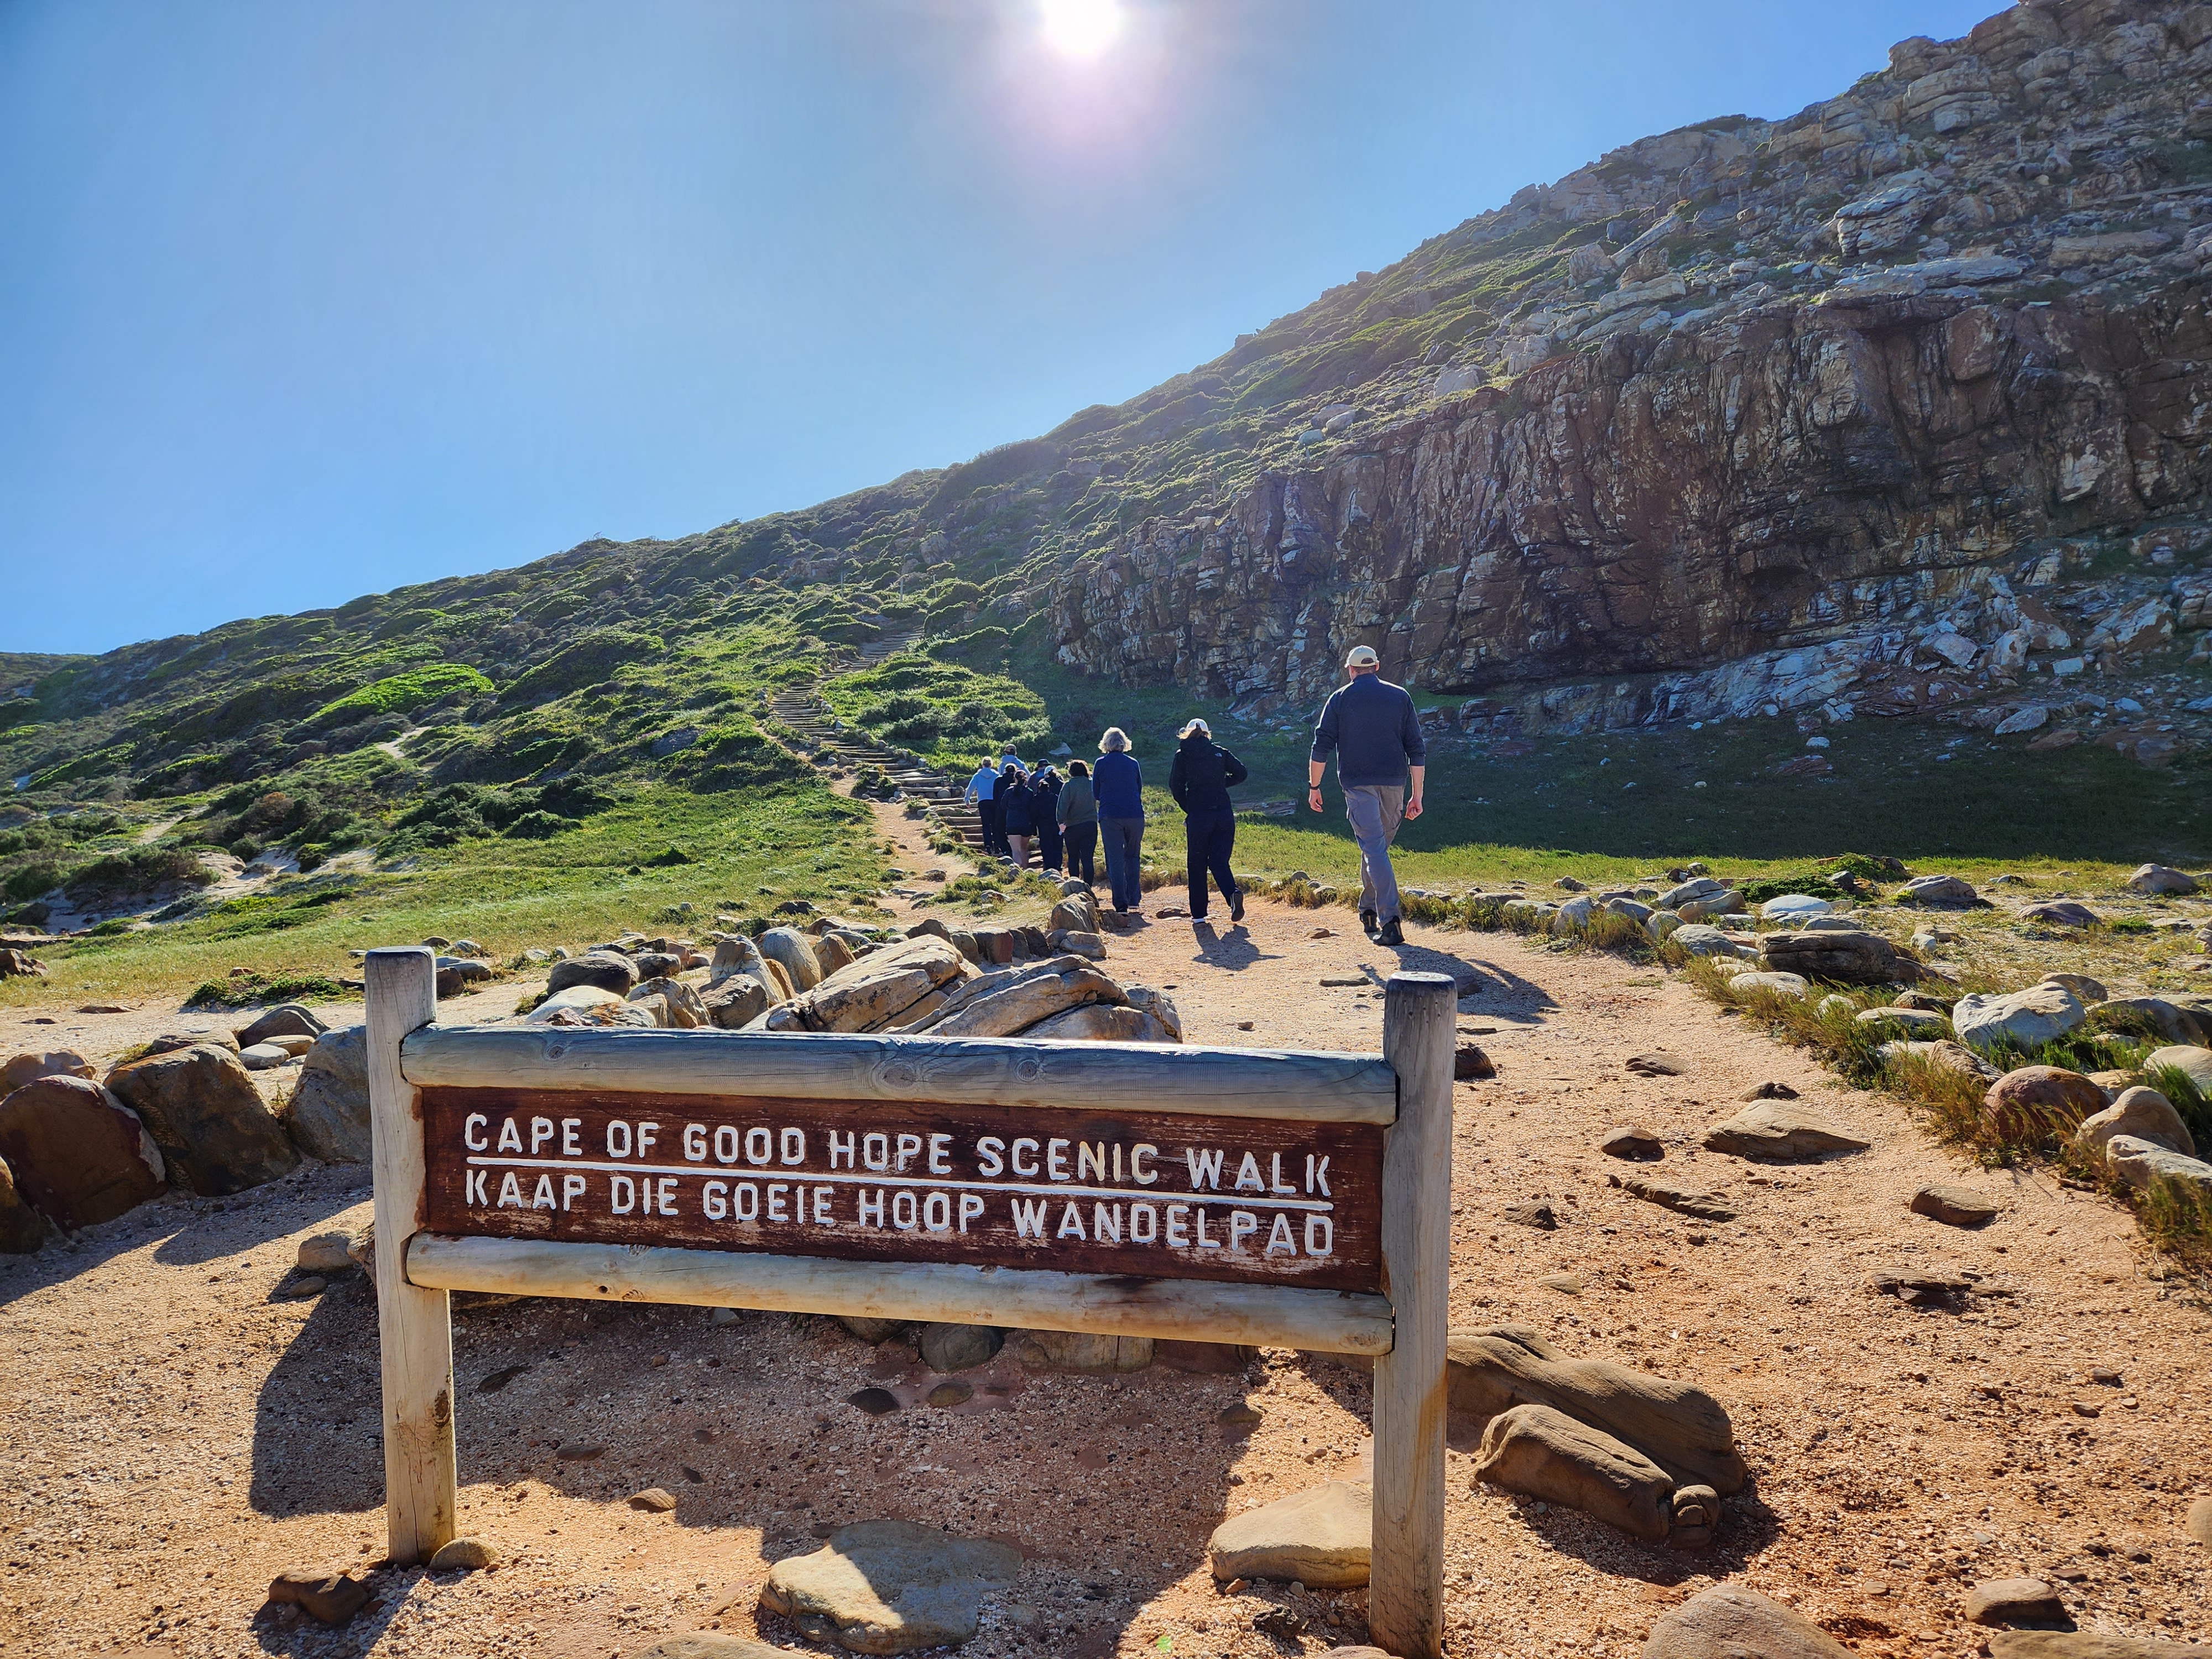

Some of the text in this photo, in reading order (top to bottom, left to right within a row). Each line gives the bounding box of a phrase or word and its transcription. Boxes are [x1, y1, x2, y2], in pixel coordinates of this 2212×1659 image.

[464, 1112, 1332, 1197] CAPE OF GOOD HOPE SCENIC WALK
[465, 1169, 1334, 1256] KAAP DIE GOEIE HOOP WANDELPAD
